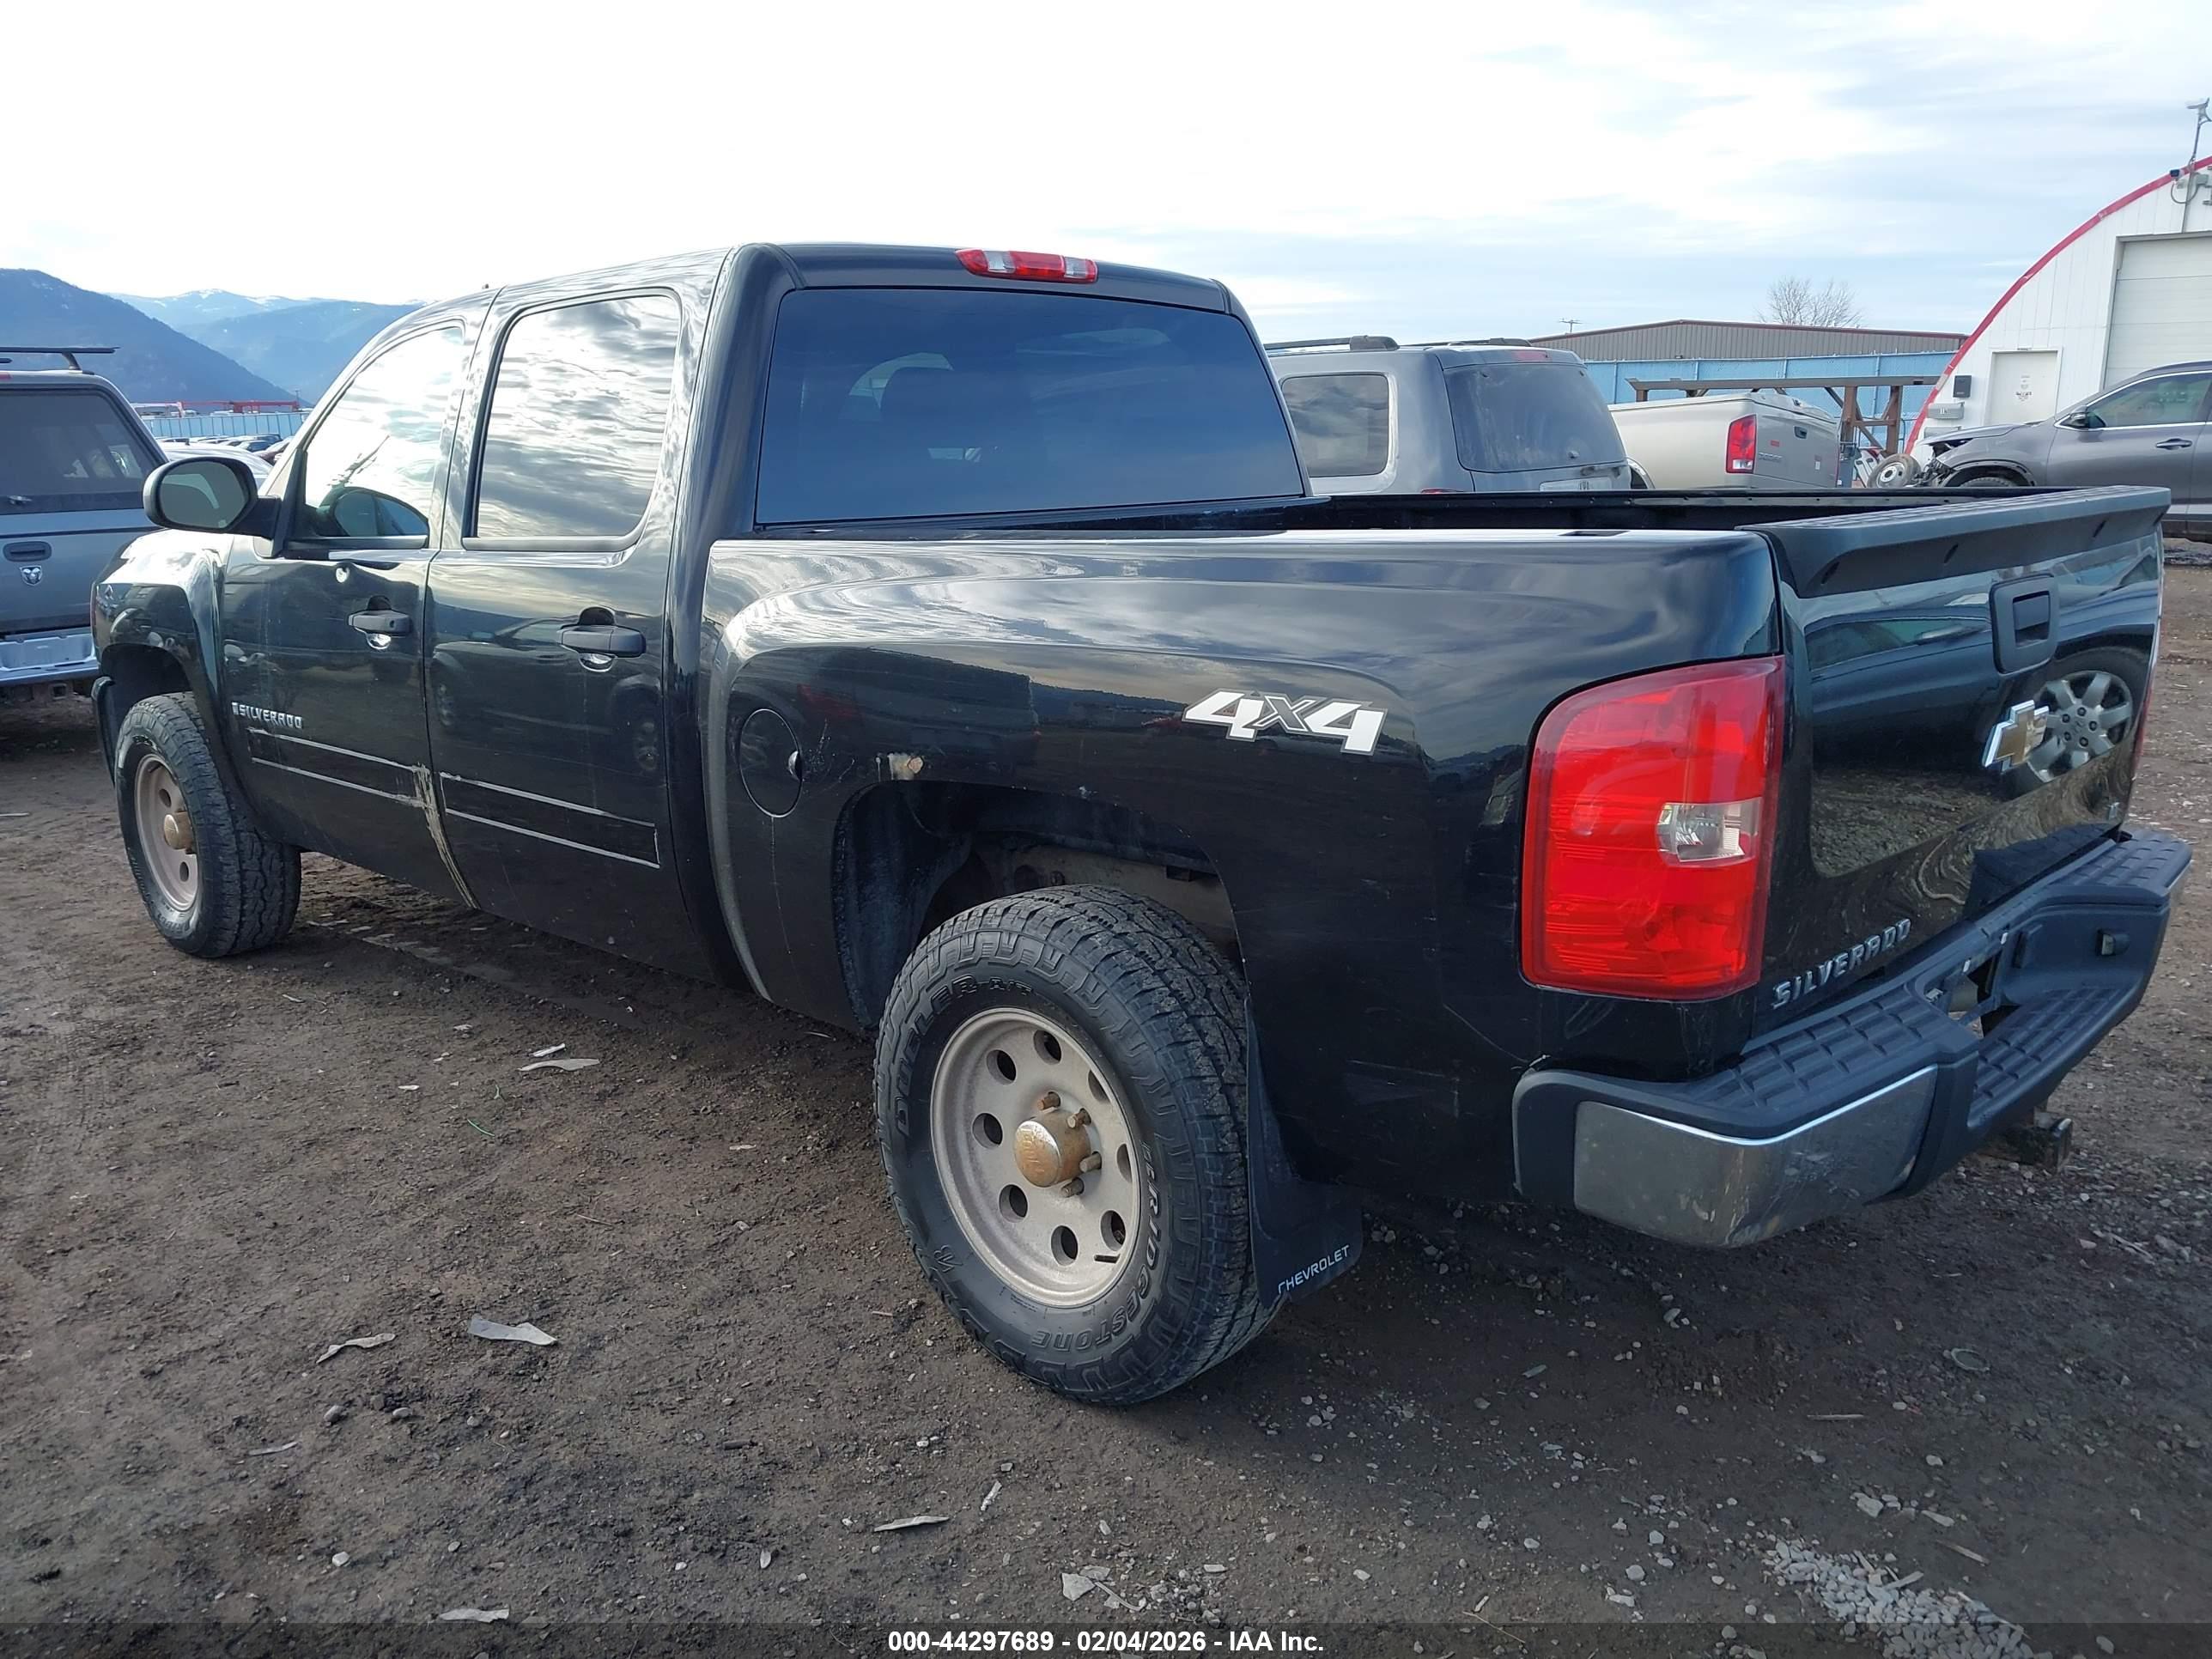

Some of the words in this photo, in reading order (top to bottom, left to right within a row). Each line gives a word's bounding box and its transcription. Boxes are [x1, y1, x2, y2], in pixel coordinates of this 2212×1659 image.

[239, 704, 303, 729] SILVERADO
[1771, 918, 1912, 1010] SILVERADO
[1277, 1243, 1350, 1295] CHEVROLET
